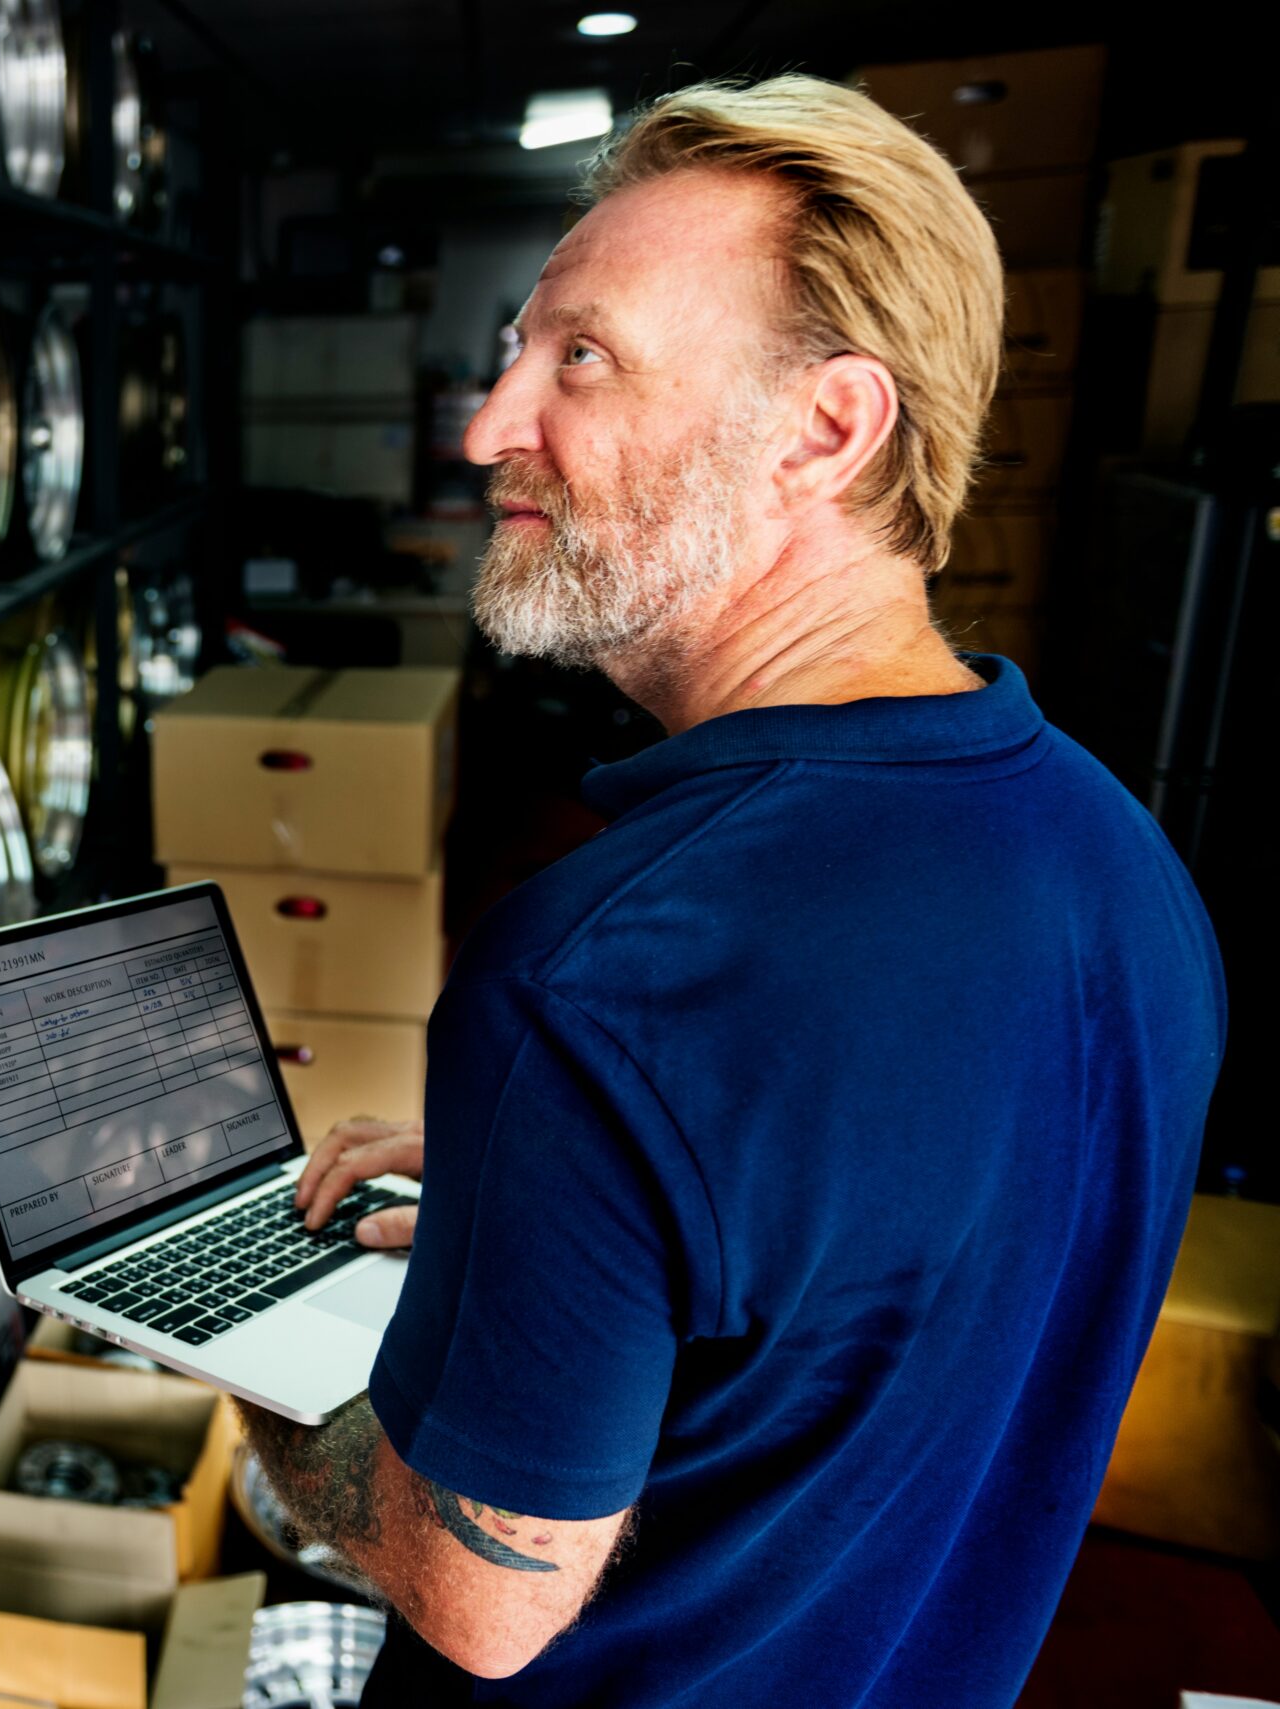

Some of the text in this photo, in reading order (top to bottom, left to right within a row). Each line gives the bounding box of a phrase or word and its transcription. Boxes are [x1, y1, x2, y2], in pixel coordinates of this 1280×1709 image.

[173, 964, 188, 974] DATE
[135, 975, 149, 985] ITEM
[43, 978, 112, 1004] WORK DESCRIPTION
[226, 1112, 261, 1132] SIGNATURE
[161, 1141, 187, 1158] LEADER
[91, 1163, 131, 1186] SIGNATURE
[10, 1191, 59, 1218] PREPARED BY
